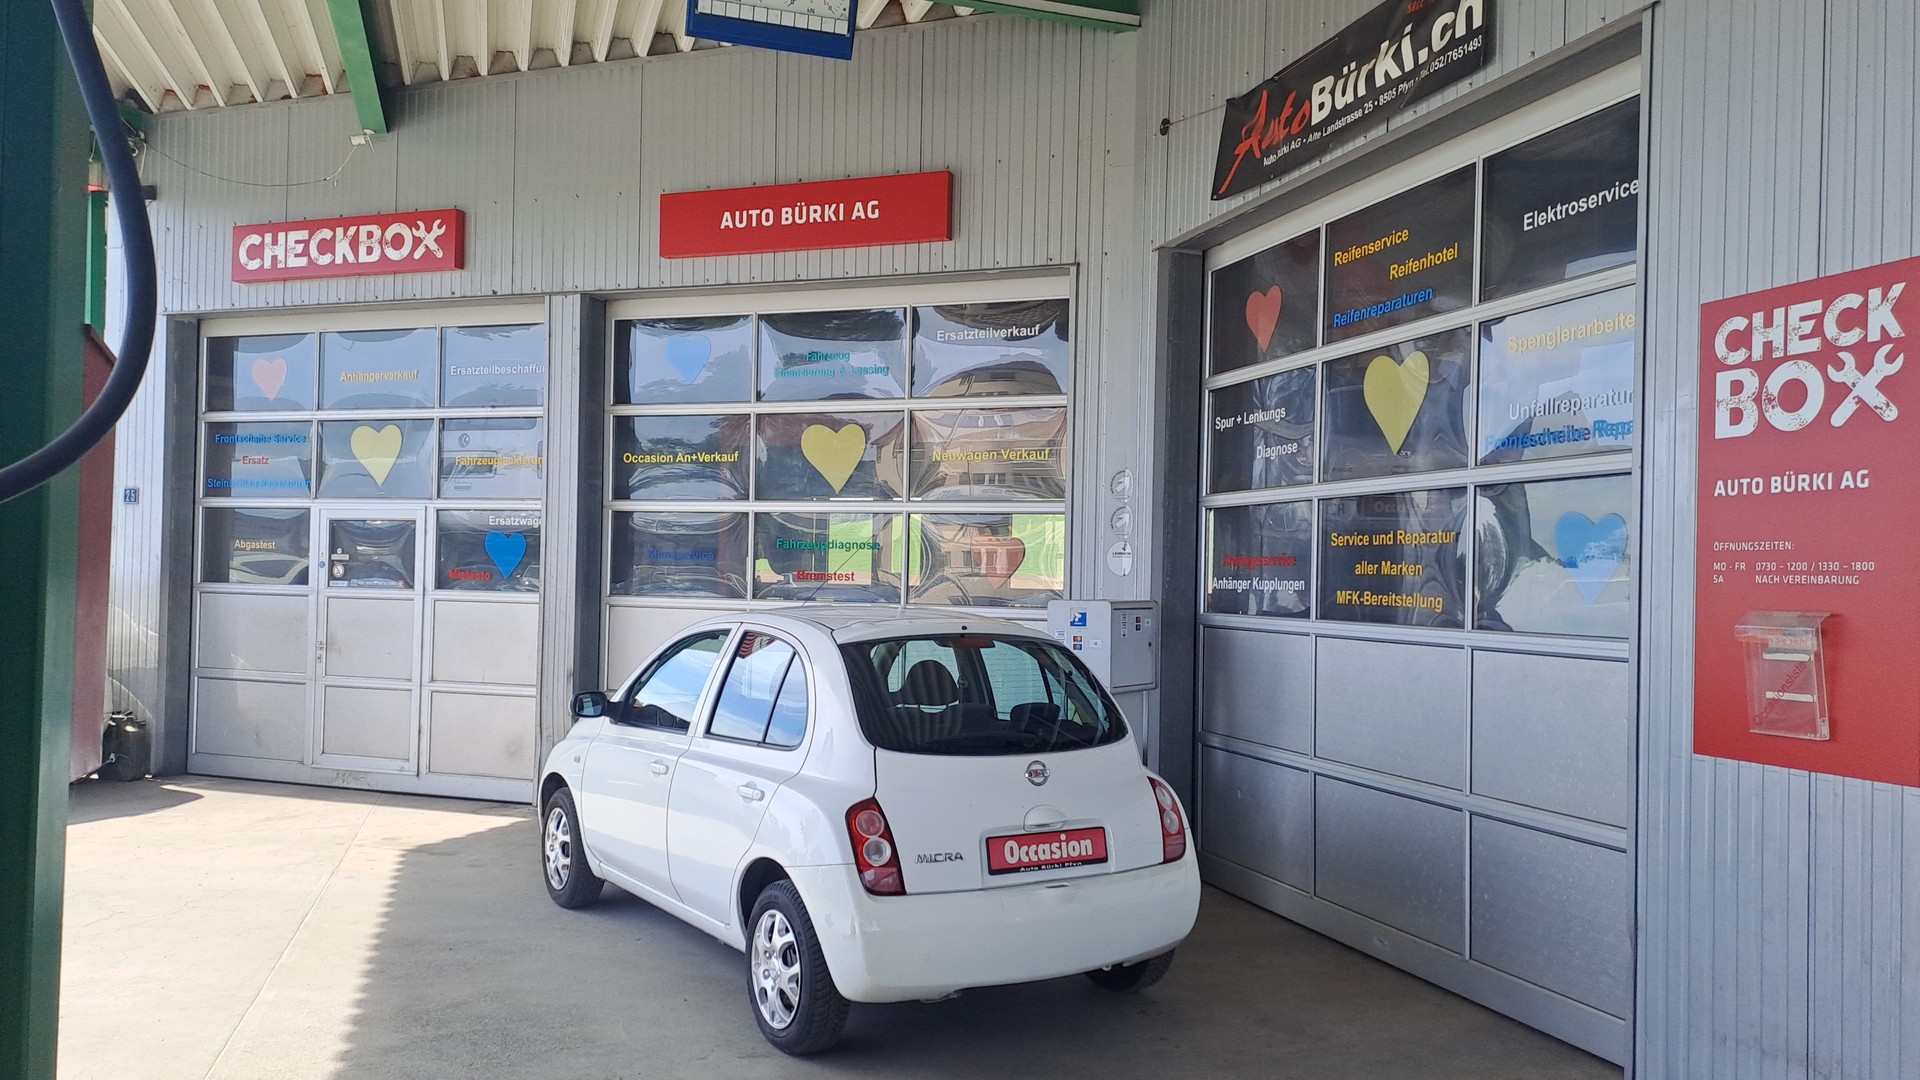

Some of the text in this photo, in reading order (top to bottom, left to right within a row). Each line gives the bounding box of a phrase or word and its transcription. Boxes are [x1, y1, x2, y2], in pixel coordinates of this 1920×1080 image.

[1290, 138, 1301, 152] AG
[1322, 108, 1363, 137] Landstrasse
[1363, 101, 1373, 114] 25
[1379, 88, 1396, 106] 8505
[1430, 35, 1482, 73] 052/7651493
[1523, 179, 1639, 231] Elektroservice
[720, 200, 879, 230] AUTO BÜRKI AG
[238, 219, 446, 271] CHECKBOX
[1334, 228, 1409, 267] Reifenservice
[1389, 243, 1458, 280] Reifenhotel
[1333, 287, 1433, 328] Reifenreparaturen
[936, 324, 1040, 342] Ersatzteilverkauf
[1714, 282, 1907, 366] CHECK
[851, 364, 890, 376] Leasing
[1714, 343, 1905, 439] BOX
[1215, 416, 1235, 431] Spur
[1243, 406, 1286, 425] Lenkungs
[242, 455, 269, 465] Ersatz
[623, 451, 739, 463] Occasion An+Verkauf
[932, 448, 1050, 463] Neuwagen Verkauf
[1256, 441, 1298, 461] Diagnose
[1714, 469, 1869, 497] AUTO BÜRKI AG
[125, 489, 136, 502] 25
[234, 539, 276, 550] Abgastest
[775, 538, 881, 552] Fahrzeugdiagnose
[1330, 530, 1456, 547] Service und Reparatur
[1713, 541, 1795, 551] ÖFFNUNGSZEITEN:
[1355, 561, 1423, 576] aller Marken
[1713, 562, 1726, 571] MO
[1734, 562, 1746, 571] FR
[1755, 562, 1776, 571] 0730
[1786, 562, 1808, 571] 1200
[1818, 562, 1840, 571] 1330
[1850, 561, 1875, 571] 1800
[796, 570, 856, 582] Bremstest
[1212, 576, 1305, 594] Anhänger Kupplungen
[1713, 575, 1860, 585] SA NACH VEREINBARUNG
[1336, 590, 1443, 612] MFK-Bereitstellung
[1004, 833, 1093, 864] Occasion
[915, 852, 964, 864] MICRA
